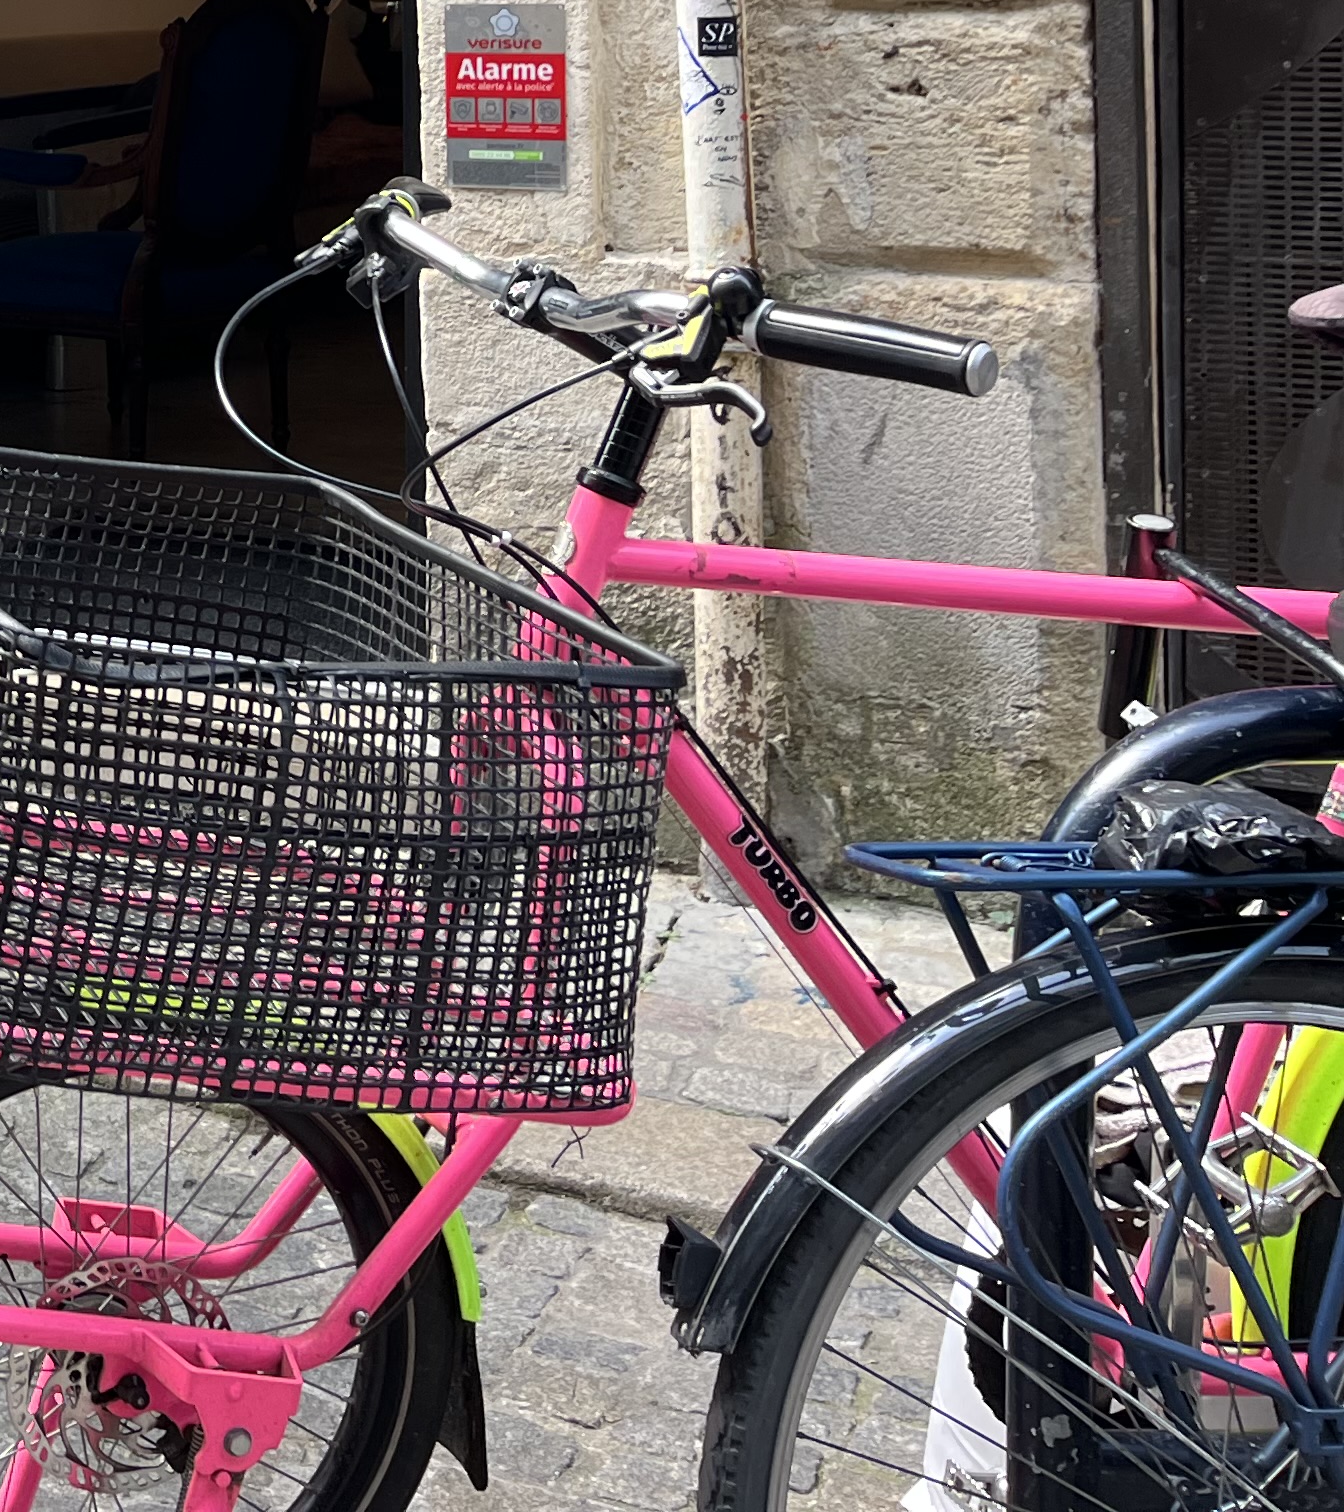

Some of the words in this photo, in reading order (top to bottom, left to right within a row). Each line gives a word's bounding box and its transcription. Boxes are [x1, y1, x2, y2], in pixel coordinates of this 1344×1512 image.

[467, 38, 542, 49] verisure
[702, 23, 735, 43] SP
[457, 57, 554, 81] Alarme
[456, 82, 476, 91] avec
[478, 82, 504, 91] alerte
[506, 82, 512, 91] à
[514, 83, 522, 91] la
[728, 814, 817, 932] TURBO
[368, 1158, 401, 1204] PLUS
